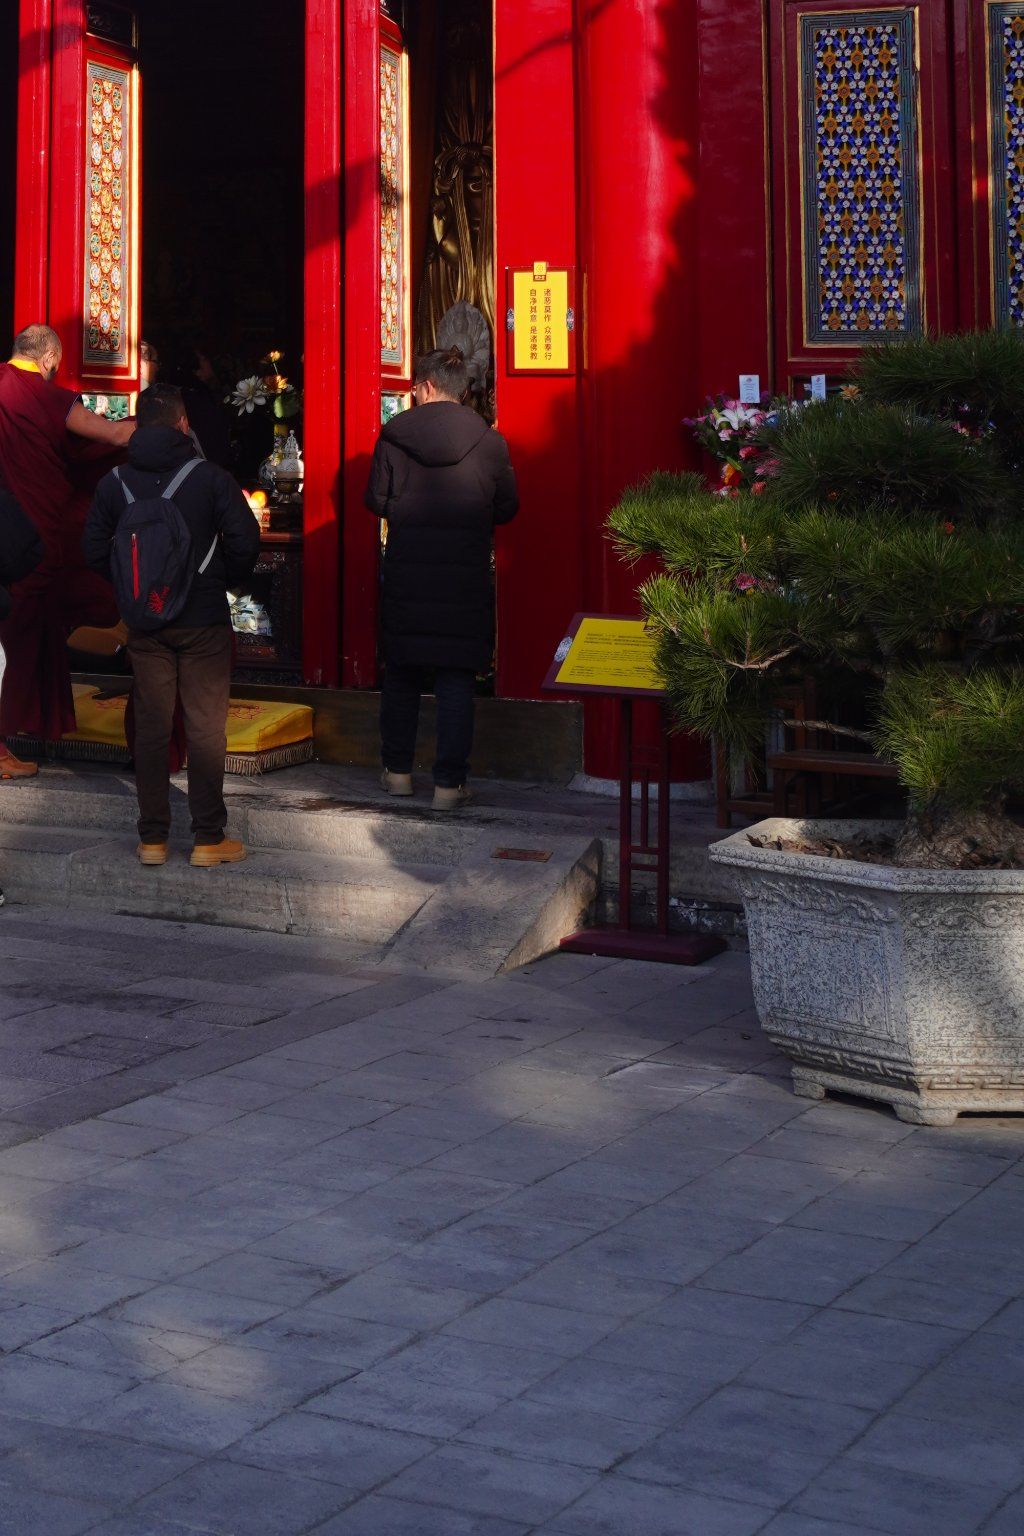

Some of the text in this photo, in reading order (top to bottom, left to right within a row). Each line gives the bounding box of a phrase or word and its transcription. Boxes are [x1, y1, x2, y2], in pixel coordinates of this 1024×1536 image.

[530, 325, 538, 361] 是诸佛教
[544, 288, 552, 361] 诸恶莫作 众善奉行
